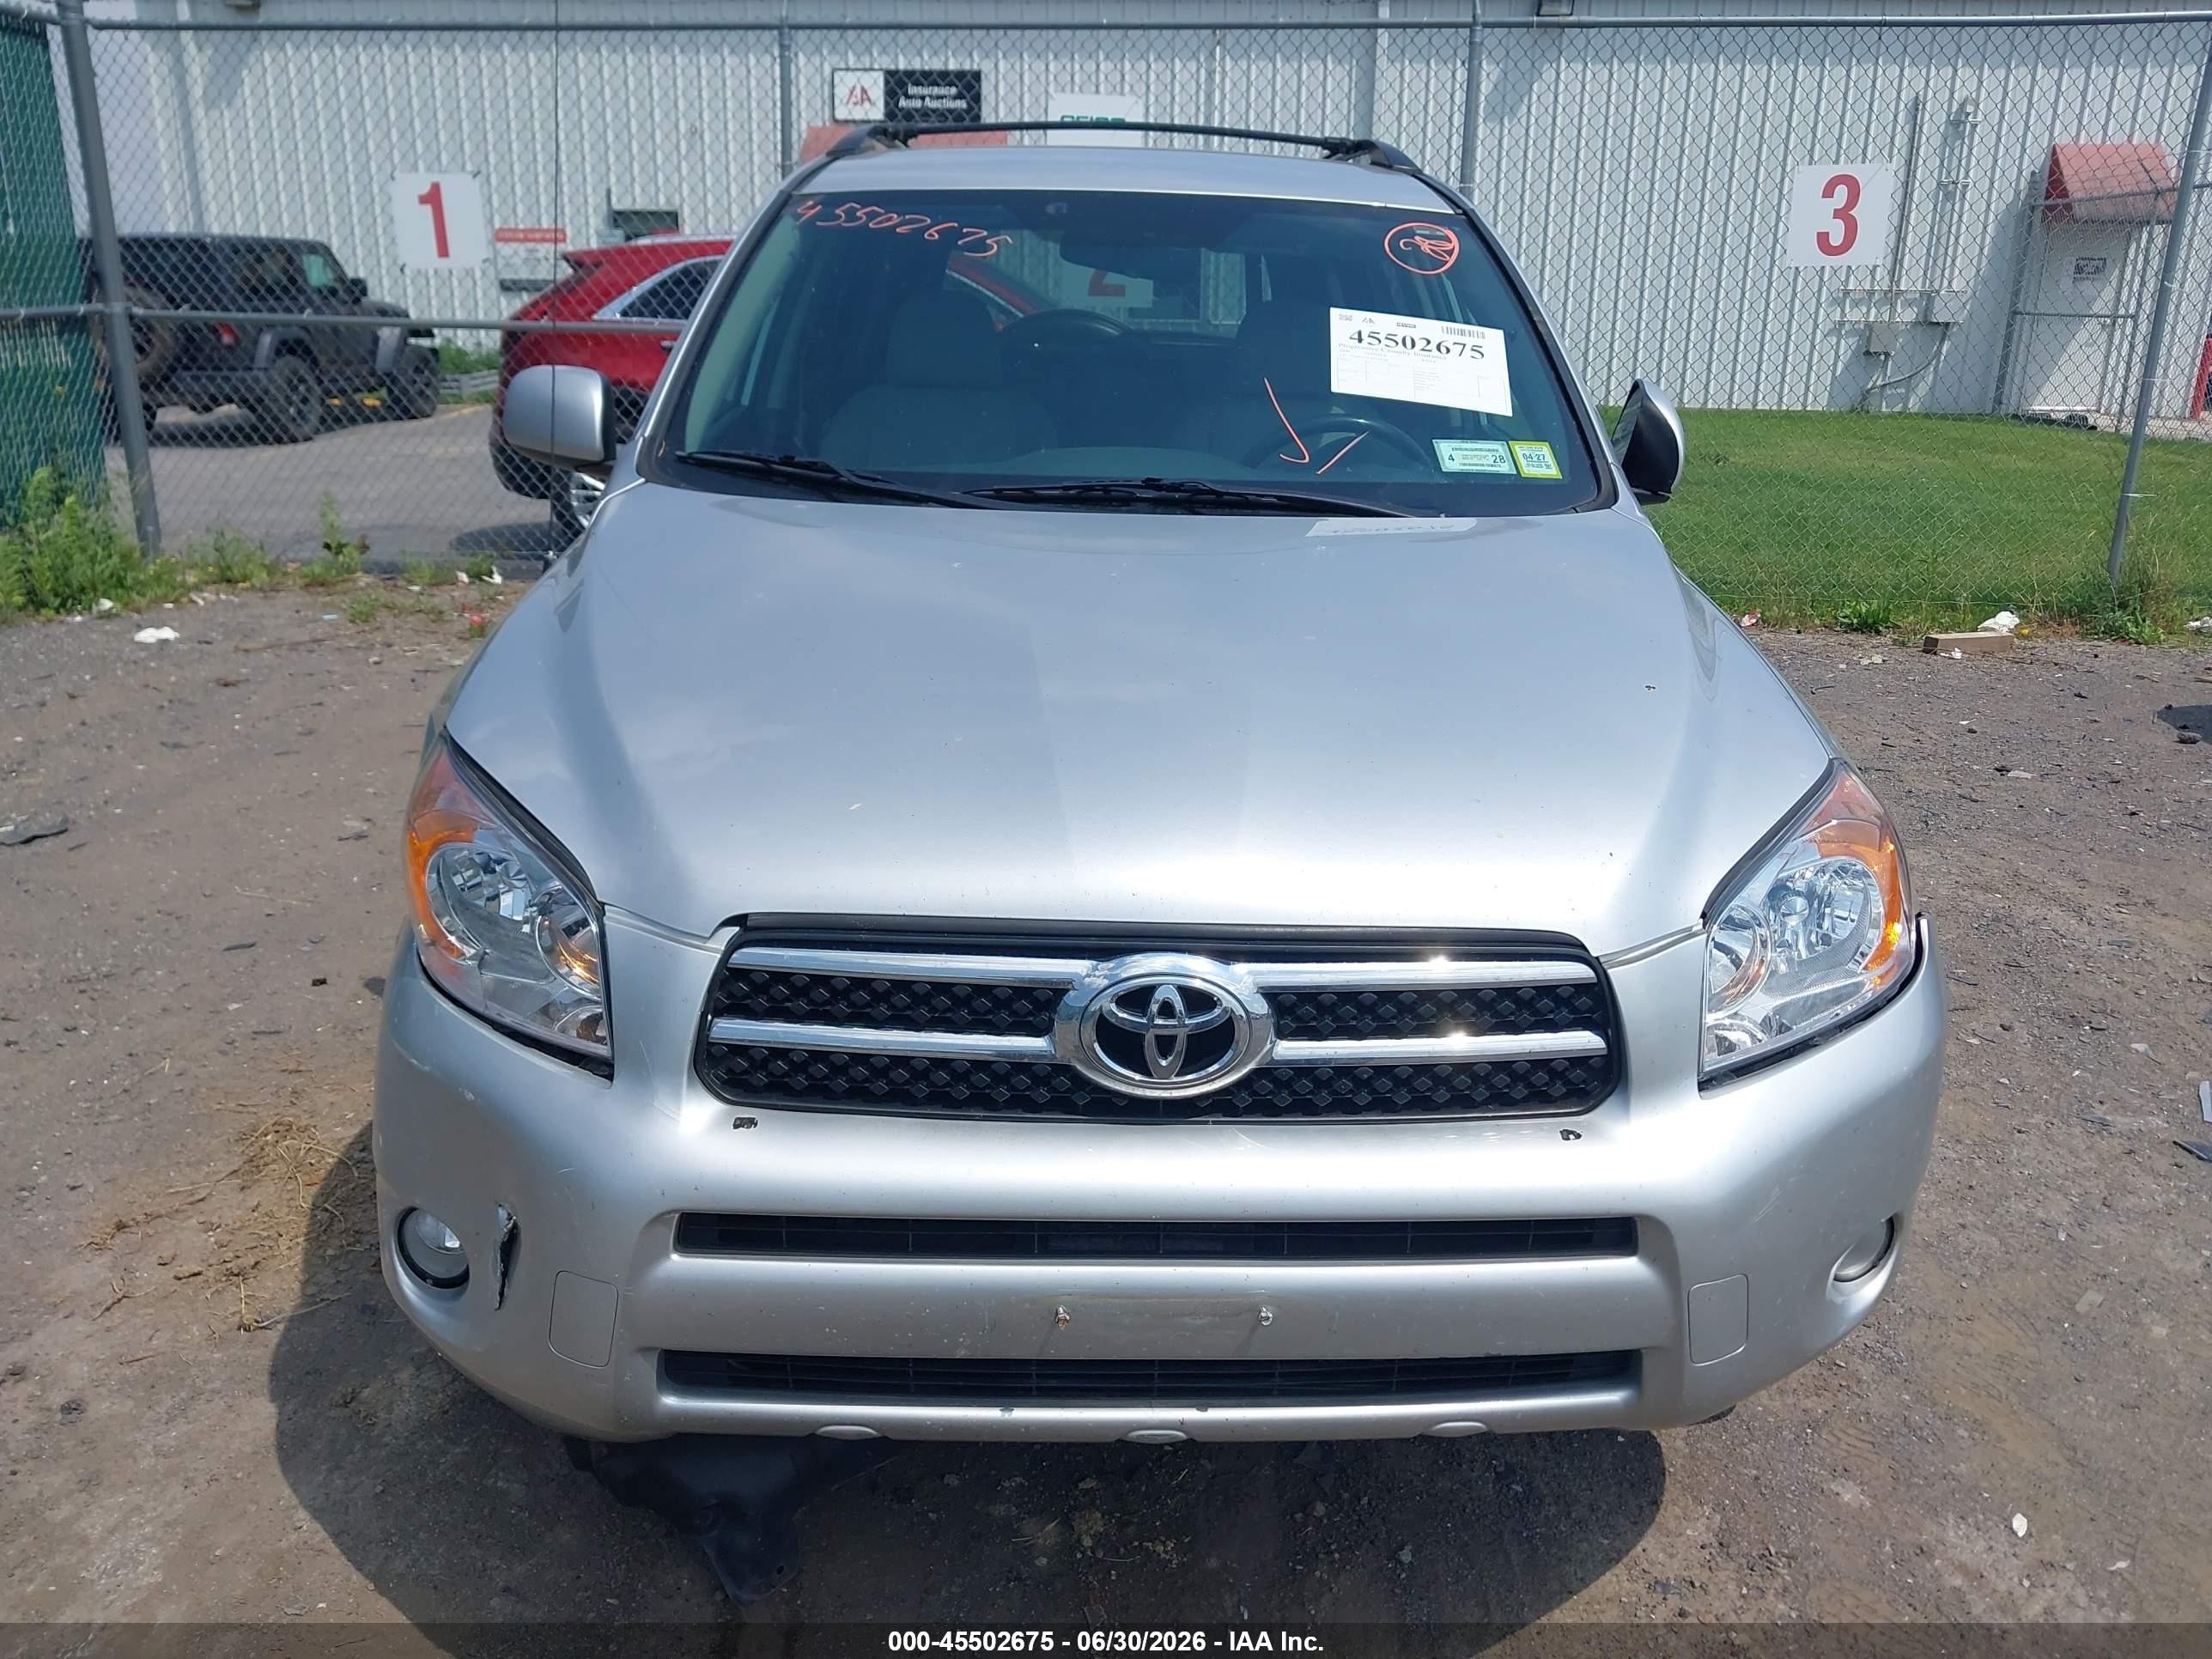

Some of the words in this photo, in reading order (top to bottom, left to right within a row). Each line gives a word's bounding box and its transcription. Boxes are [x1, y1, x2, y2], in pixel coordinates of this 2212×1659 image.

[898, 95, 922, 108] Auto
[924, 95, 968, 109] Auctions
[907, 83, 958, 96] Insurance
[418, 182, 449, 258] 1
[796, 200, 1013, 257] 45502675
[1815, 173, 1862, 257] 3
[1349, 329, 1485, 360] 45502675
[1448, 453, 1455, 463] 4
[1491, 454, 1506, 464] 28
